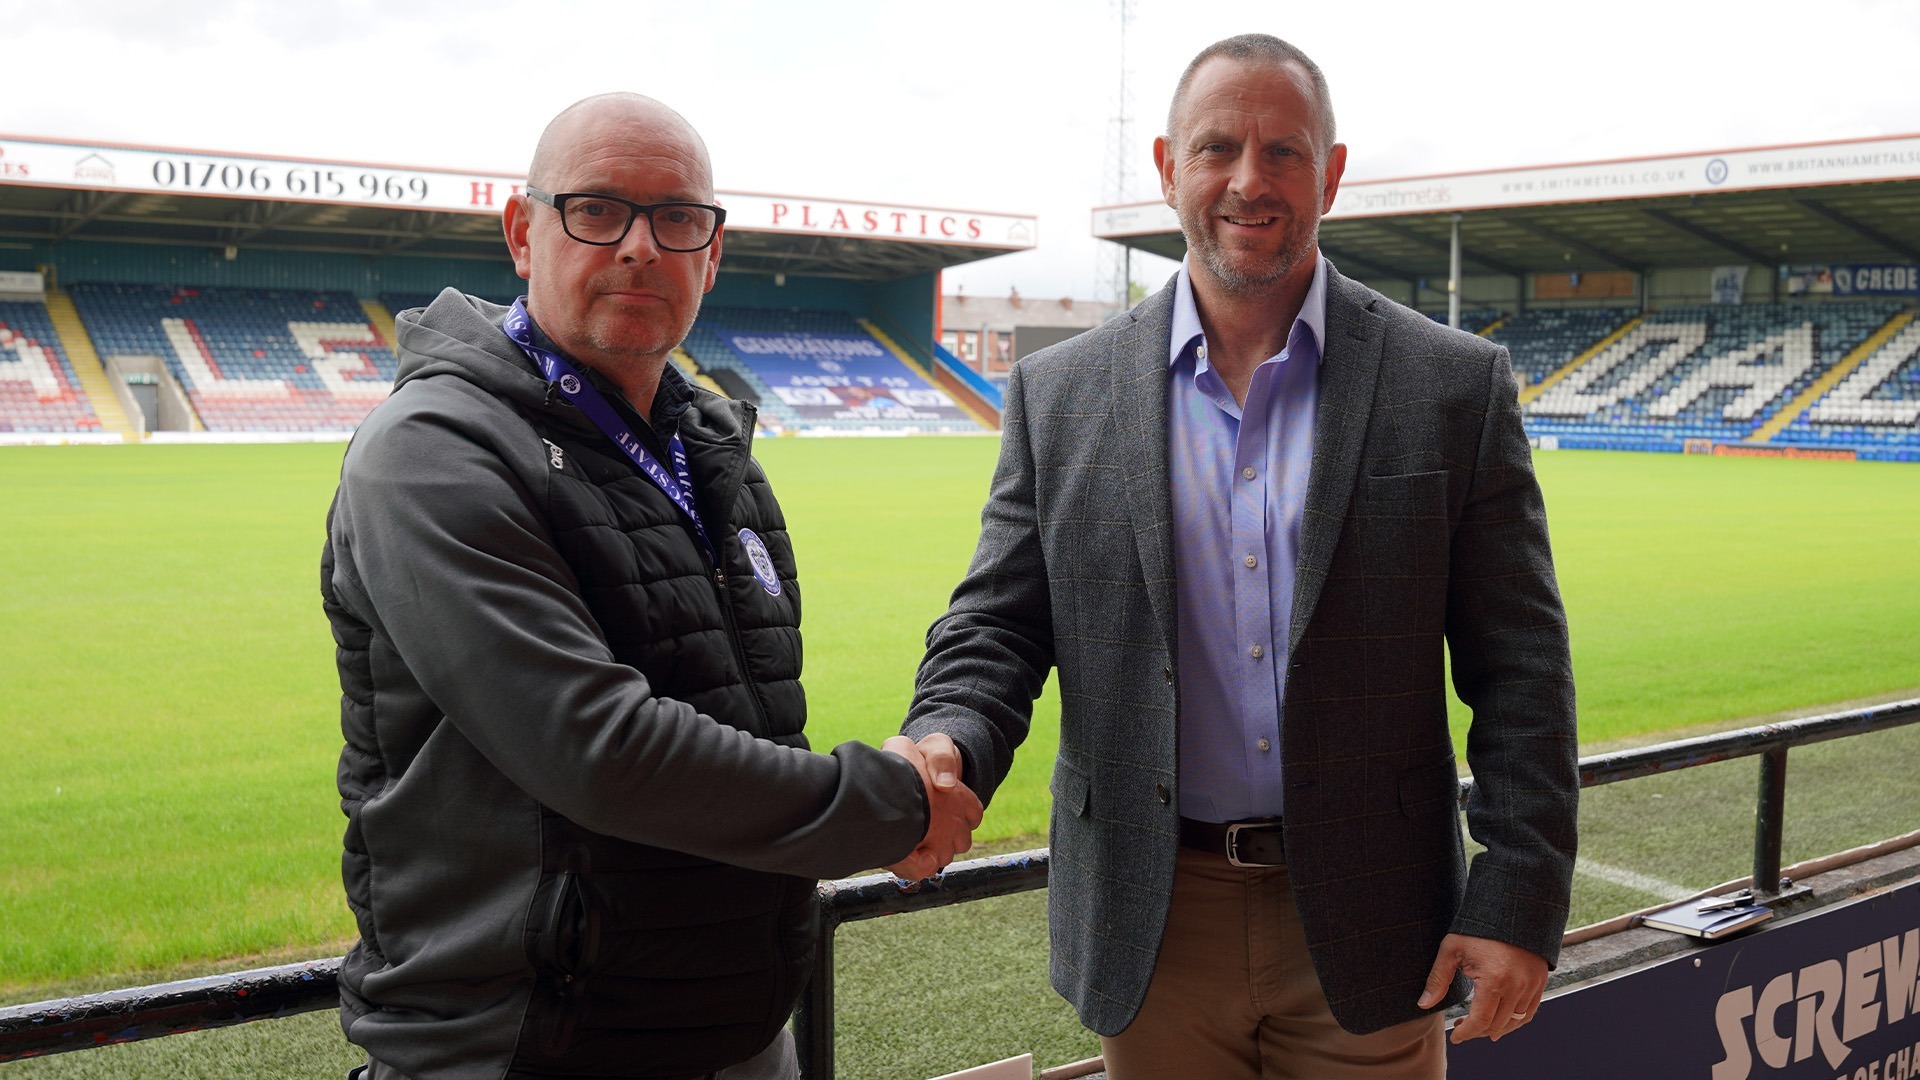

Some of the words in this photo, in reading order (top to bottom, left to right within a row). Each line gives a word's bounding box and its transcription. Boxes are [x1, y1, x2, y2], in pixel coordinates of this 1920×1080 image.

[152, 159, 271, 192] 01706
[286, 168, 345, 196] 615
[358, 173, 428, 200] 969
[1501, 169, 1687, 193] WWW.SMITHMETALS.CO.UK
[1363, 185, 1452, 209] smithmetals
[772, 203, 981, 238] PLASTICS
[1855, 268, 1917, 291] CREDE
[732, 336, 884, 357] GENERATIONS
[615, 432, 669, 487] STAFF
[1711, 927, 1920, 1080] SCREW
